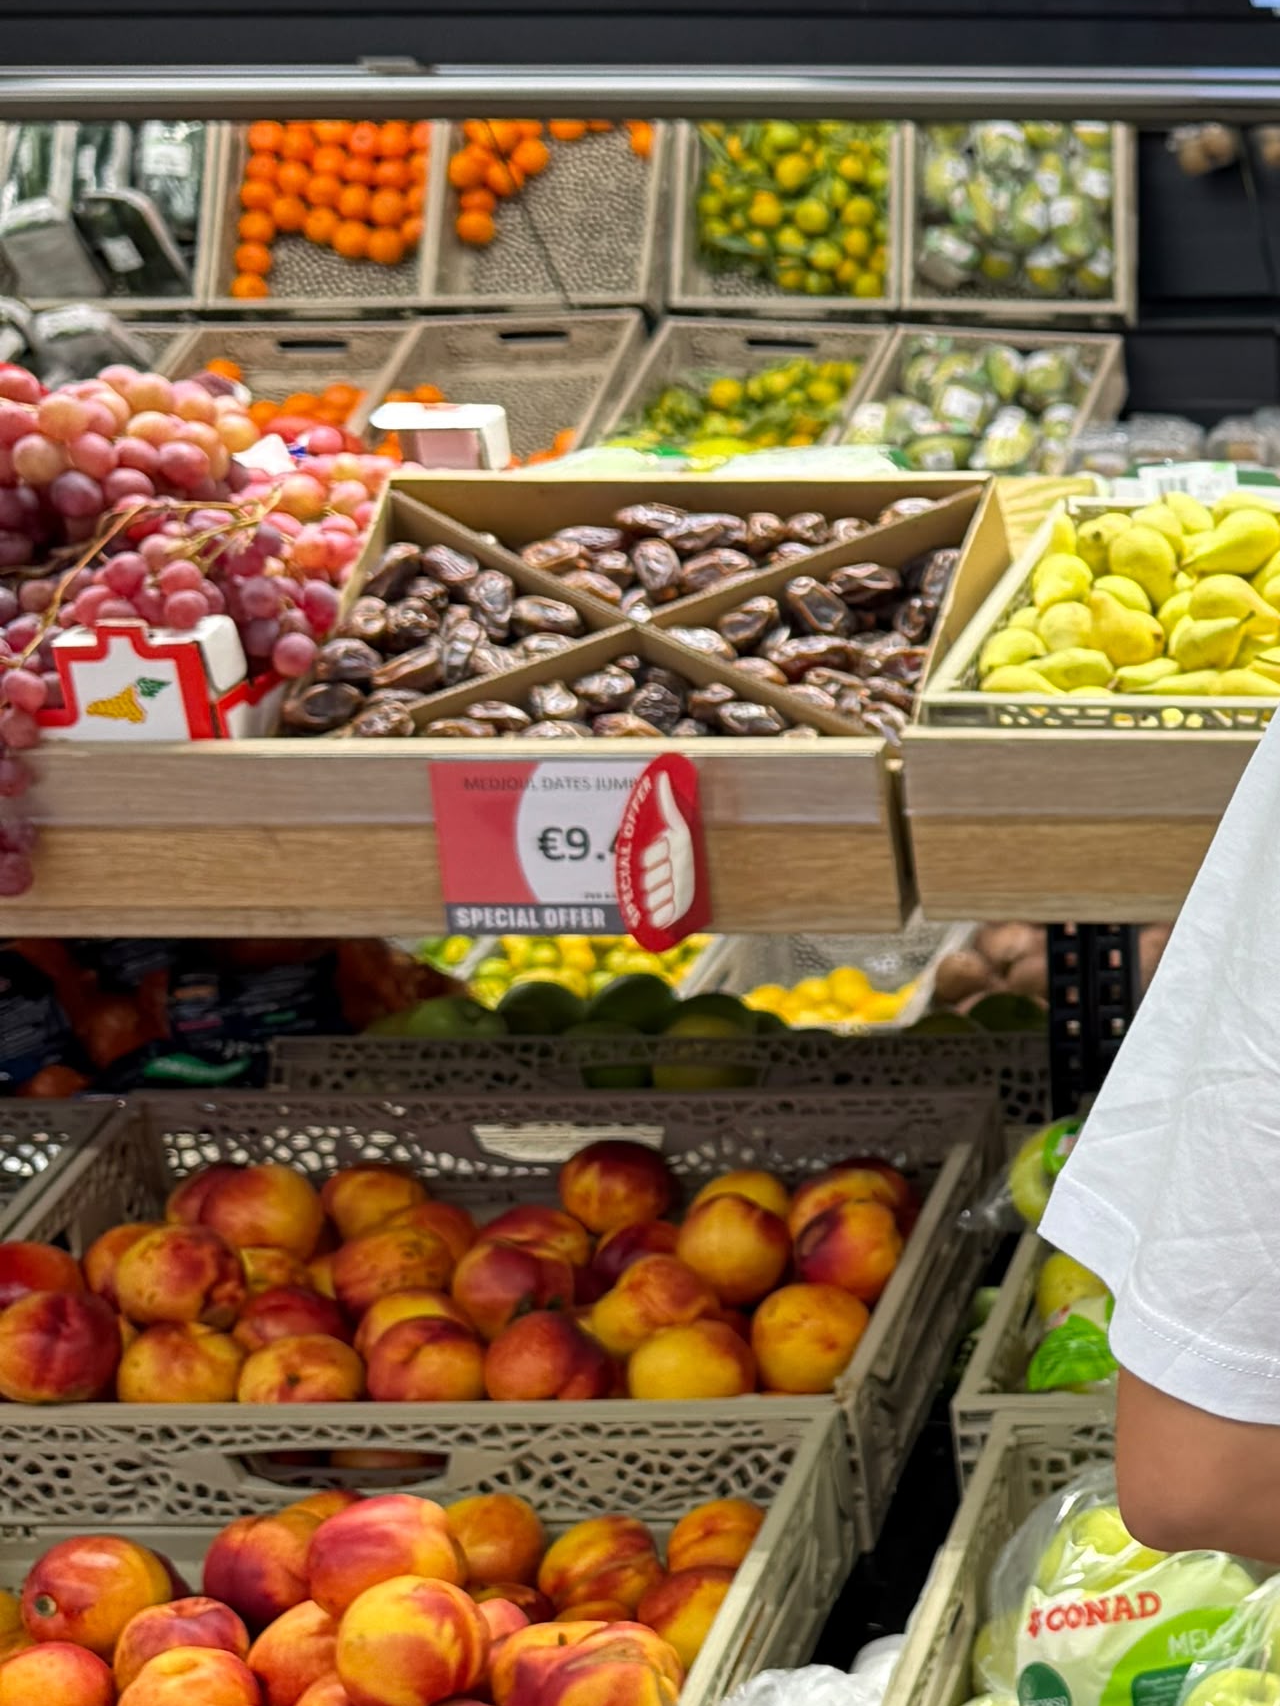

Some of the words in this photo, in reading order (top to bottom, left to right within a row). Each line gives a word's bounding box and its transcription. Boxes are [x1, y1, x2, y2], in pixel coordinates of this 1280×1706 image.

[541, 777, 592, 790] DATES
[596, 777, 636, 790] JUM
[537, 826, 619, 861] €9.
[455, 907, 540, 928] SPECIAL
[543, 907, 606, 928] OFFER
[1045, 1591, 1163, 1632] CONAD
[1167, 1627, 1211, 1659] MEL
